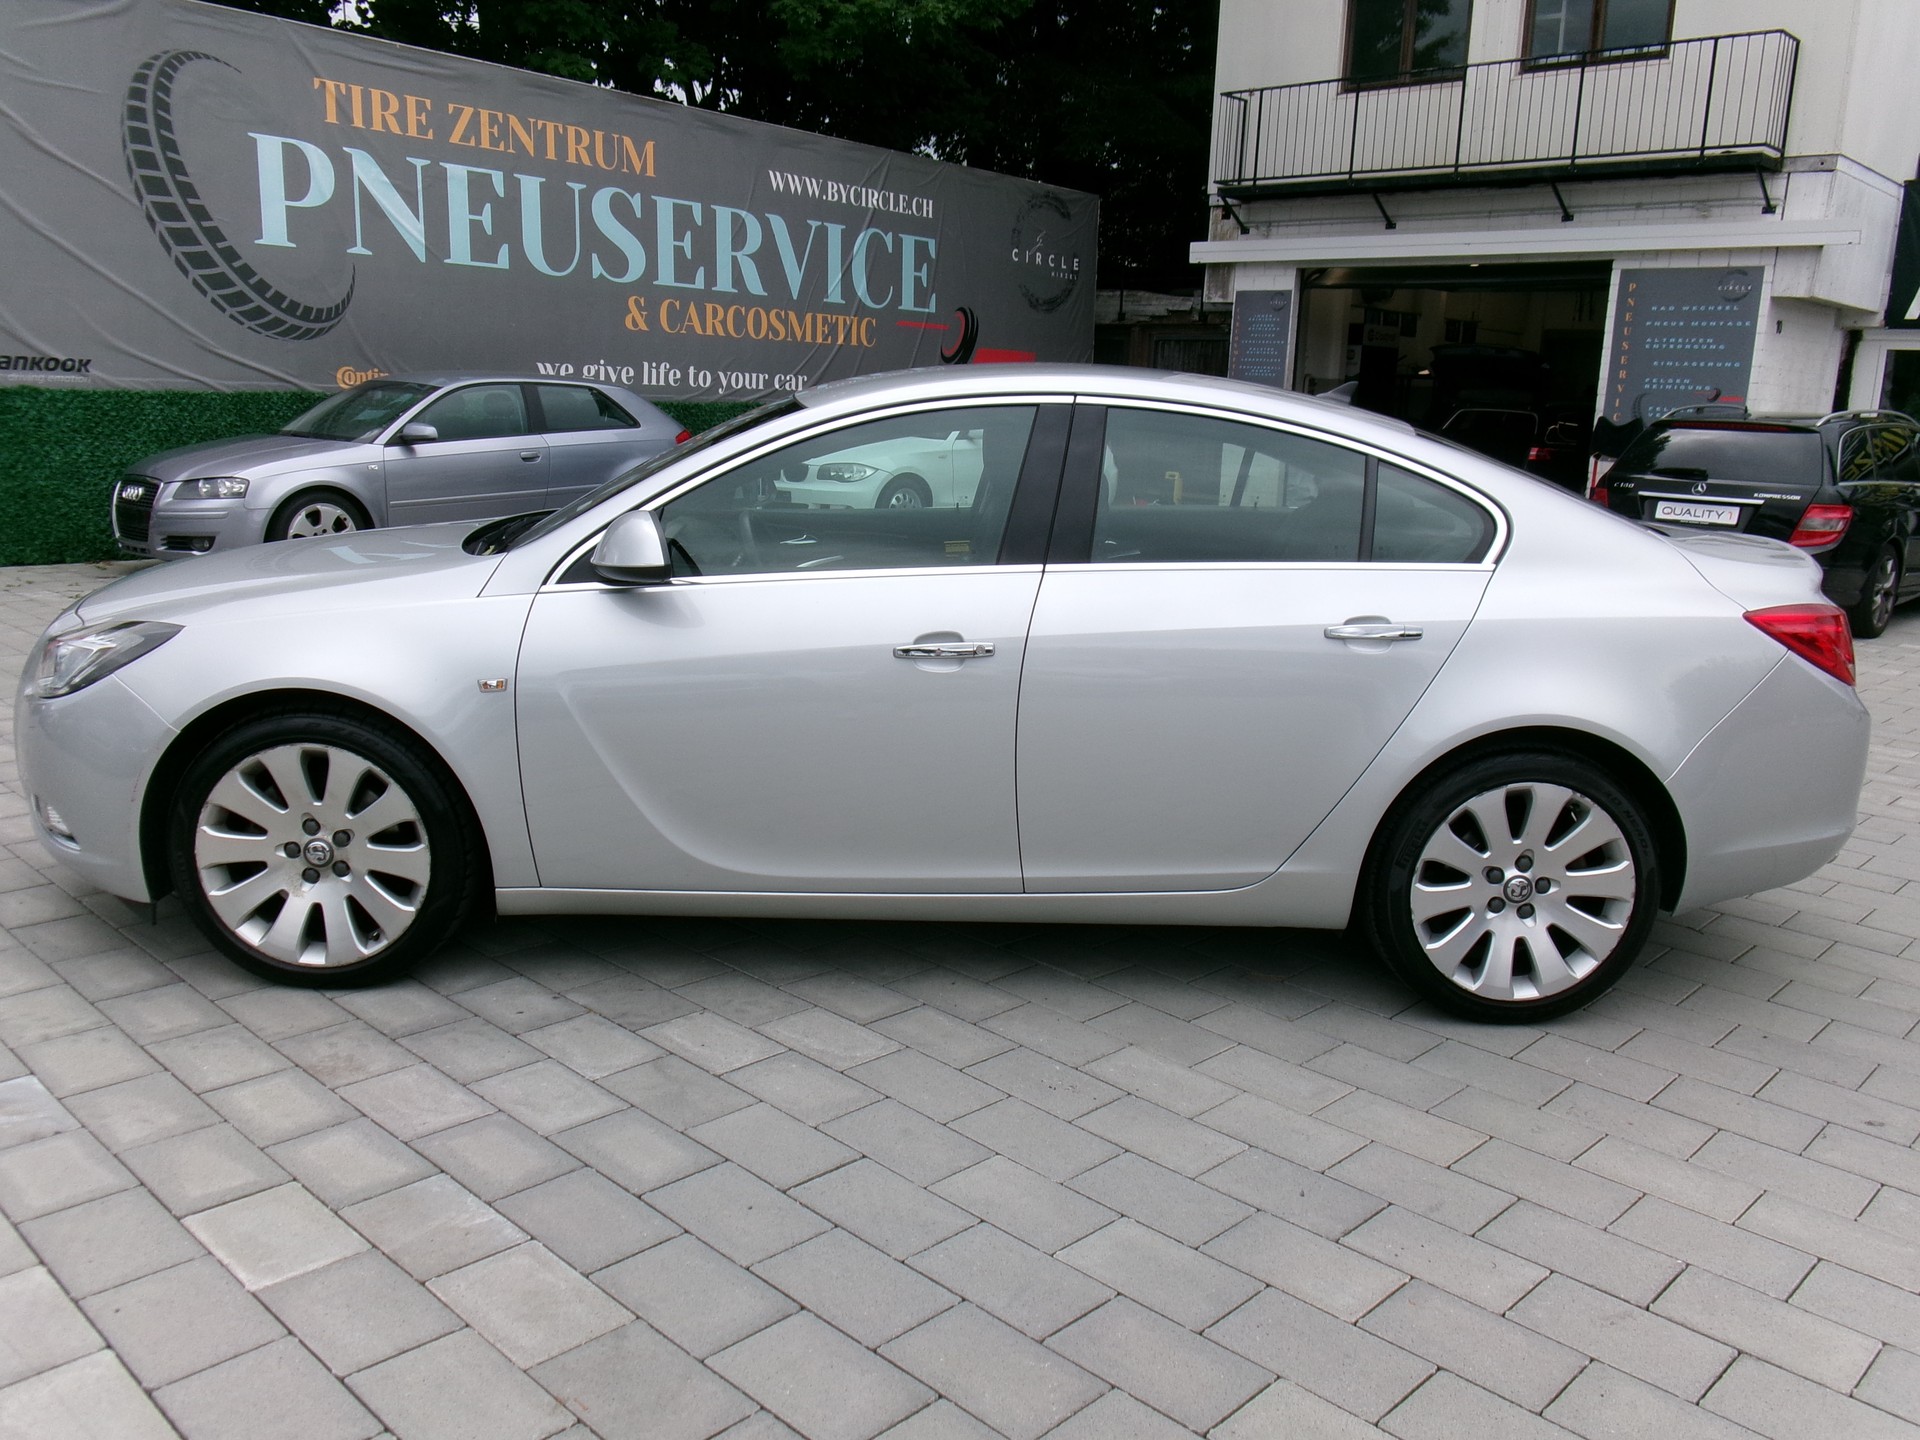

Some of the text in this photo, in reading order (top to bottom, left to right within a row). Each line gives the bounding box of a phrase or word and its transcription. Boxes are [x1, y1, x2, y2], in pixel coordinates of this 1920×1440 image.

[313, 76, 657, 178] TIRE ZENTRUM
[768, 169, 934, 219] WWW.BYCIRCLE.CH
[246, 131, 936, 314] PNEUSERVICE
[1011, 247, 1080, 271] CIRCLE
[624, 295, 877, 348] & CARCOSMETIC
[0, 355, 92, 373] ankook
[1612, 282, 1637, 422] PNEUSERVIC
[641, 360, 682, 387] life
[687, 365, 712, 388] to
[717, 370, 769, 395] your
[773, 372, 808, 391] car
[1661, 505, 1734, 521] QUALITY 1
[1753, 492, 1802, 501] KOMPRESSOR
